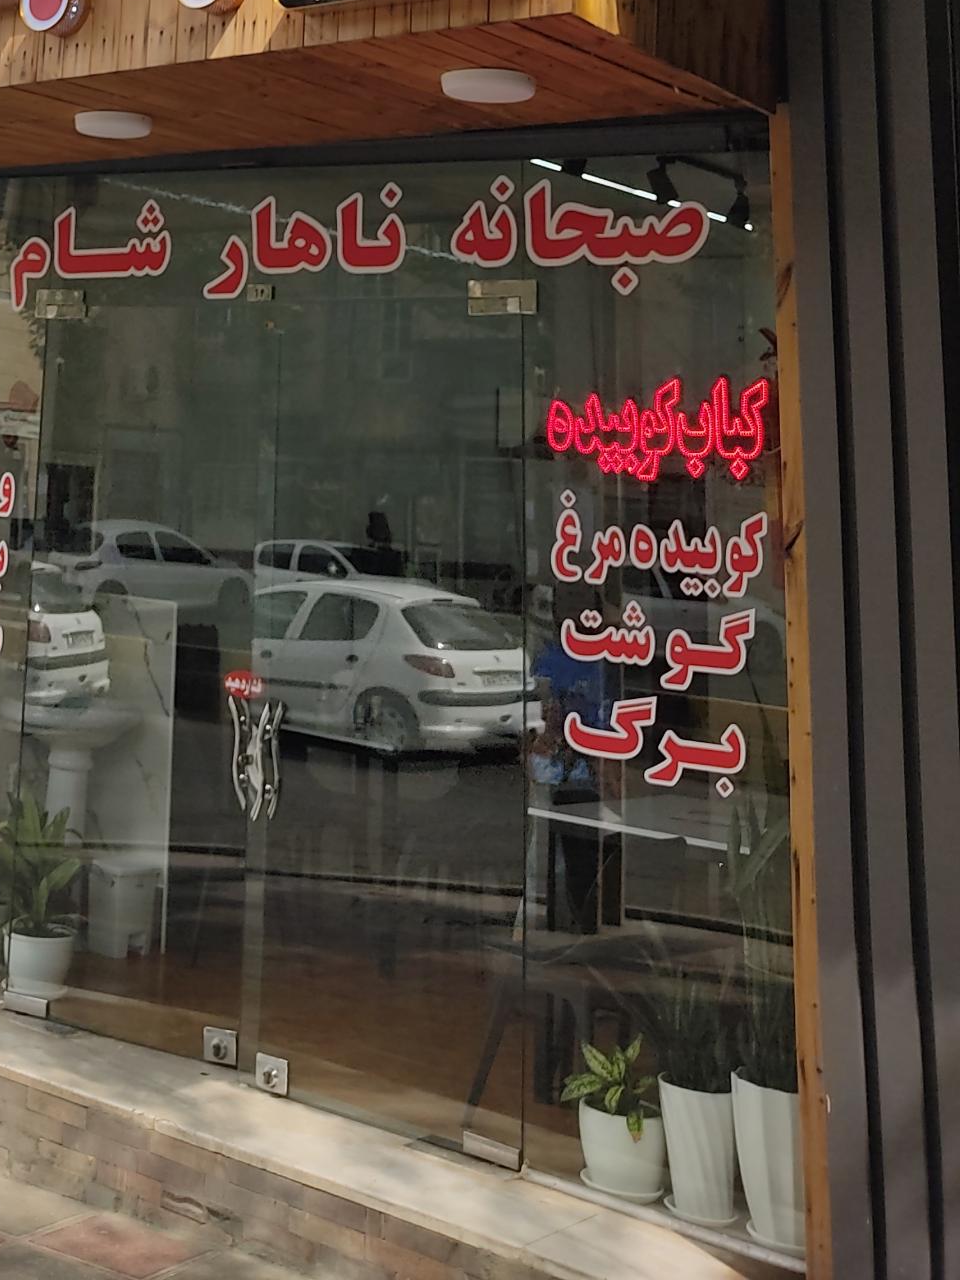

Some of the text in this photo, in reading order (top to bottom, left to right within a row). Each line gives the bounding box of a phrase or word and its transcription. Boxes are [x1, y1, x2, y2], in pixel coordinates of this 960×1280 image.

[10, 175, 710, 311] صبحانه ناهار شام
[546, 375, 770, 482] کباب کوبیده
[550, 488, 768, 599] کوبیده مرغ
[560, 600, 755, 691] گوشت
[564, 695, 746, 797] برگ
